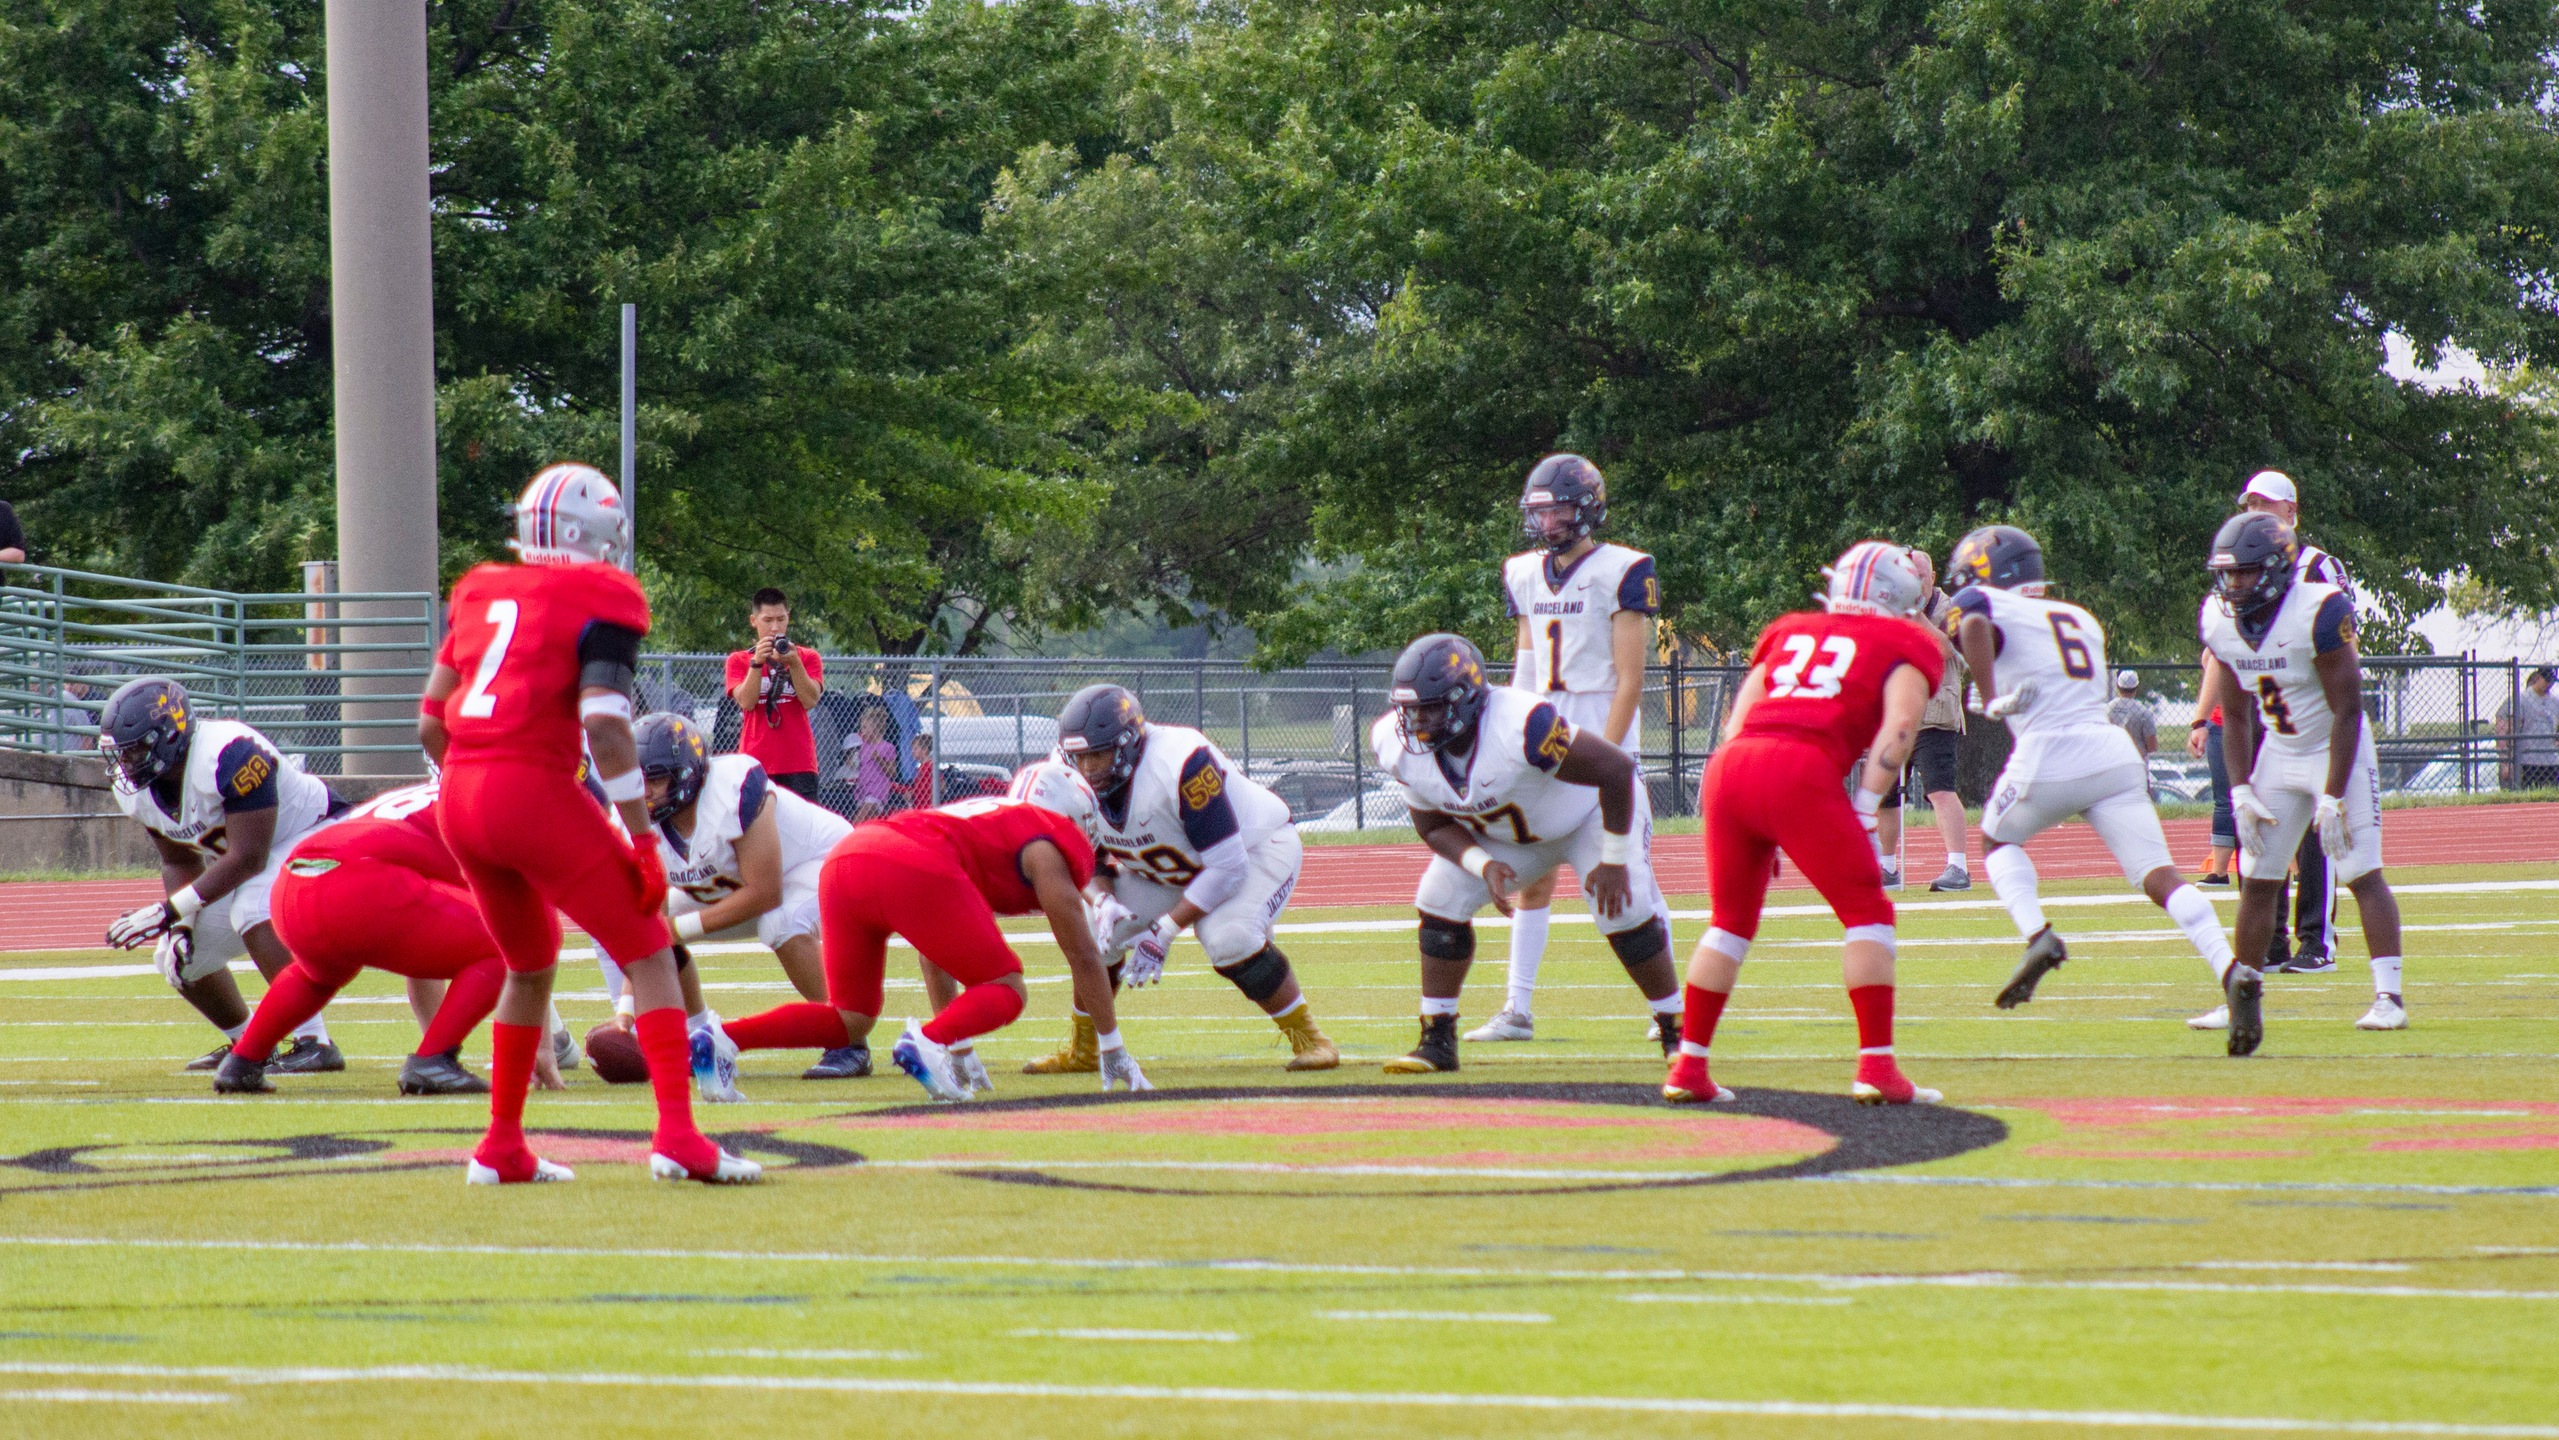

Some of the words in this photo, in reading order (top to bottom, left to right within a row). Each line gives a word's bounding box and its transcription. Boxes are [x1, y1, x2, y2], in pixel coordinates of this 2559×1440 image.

[1533, 600, 1584, 616] GRACELAND
[1644, 577, 1658, 608] 1
[459, 599, 519, 718] 2
[1546, 619, 1567, 692] 1
[1768, 633, 1857, 699] 33
[2046, 610, 2096, 681] 6
[2235, 656, 2288, 671] GRACELAND
[2258, 674, 2298, 736] 4
[232, 754, 271, 797] 58
[1181, 764, 1224, 811] 59
[1442, 796, 1500, 815] GRACELAND
[1103, 832, 1157, 849] GRACELAND
[669, 863, 718, 884] GRACELAND
[1266, 871, 1295, 919] JACKETS
